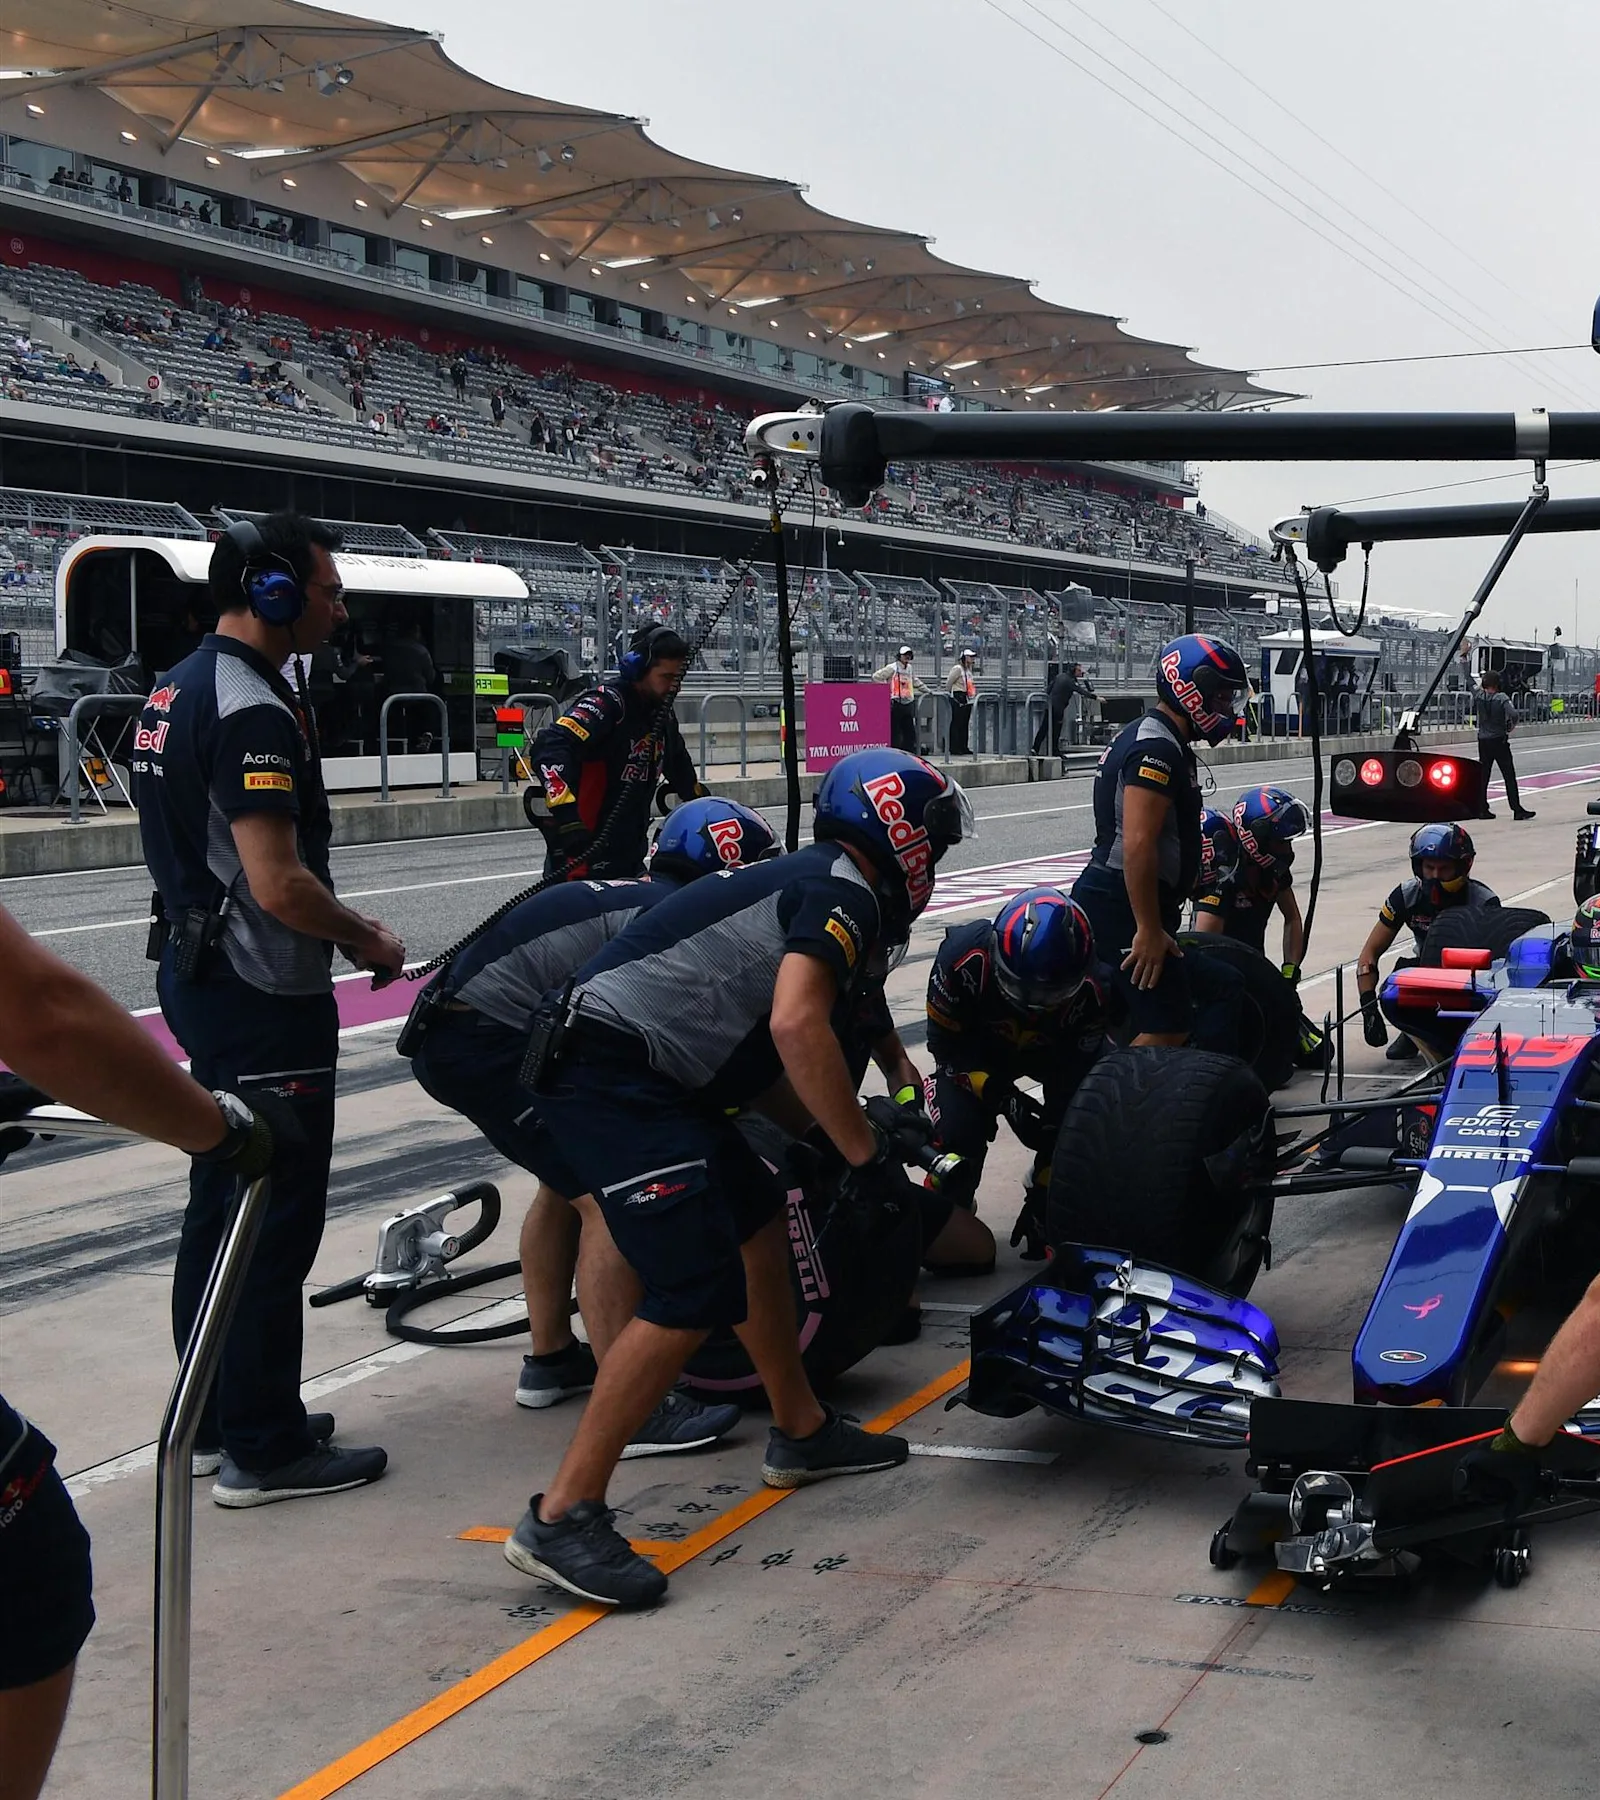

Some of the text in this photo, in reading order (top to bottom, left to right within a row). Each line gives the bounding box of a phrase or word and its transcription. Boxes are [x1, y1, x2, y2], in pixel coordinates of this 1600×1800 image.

[370, 558, 429, 571] HONDA
[1161, 650, 1222, 734] Red Bull
[840, 721, 859, 732] TATA
[809, 746, 829, 758] TATA
[242, 752, 292, 768] Acronis
[249, 775, 291, 788] PIRELLI
[861, 771, 928, 851] Red
[1233, 801, 1253, 841] Red
[1445, 1117, 1542, 1129] EDIFICE
[1458, 1128, 1521, 1137] CASIO
[1429, 1145, 1533, 1163] PIRELLI
[636, 1193, 656, 1204] Toro
[786, 1188, 830, 1302] PIRELLI
